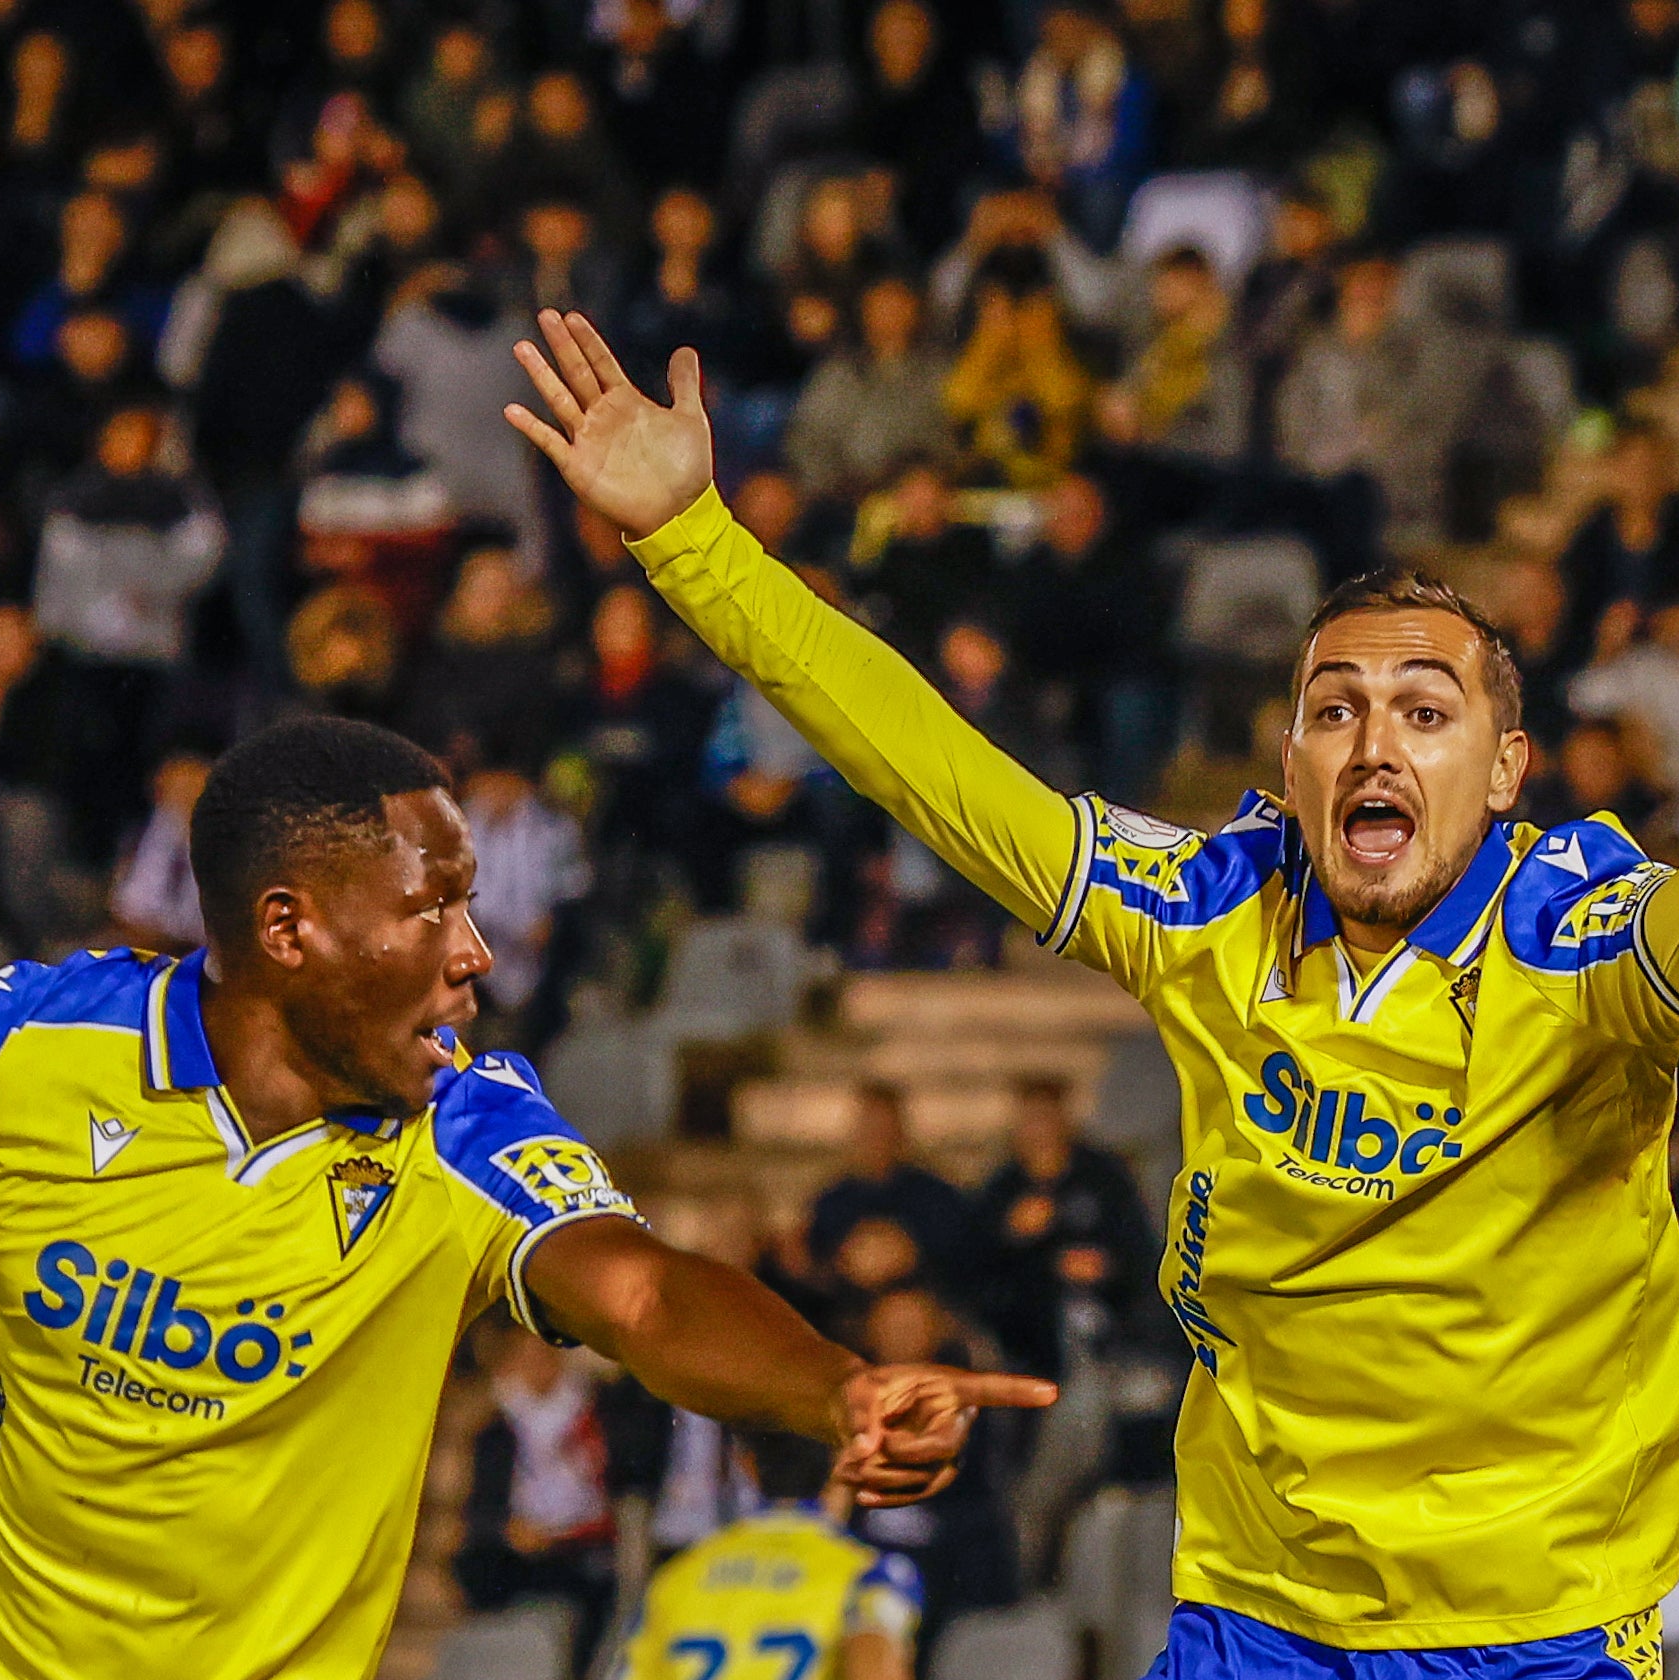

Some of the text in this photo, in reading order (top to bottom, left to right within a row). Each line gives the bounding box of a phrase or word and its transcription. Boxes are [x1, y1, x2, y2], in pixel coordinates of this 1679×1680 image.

[1274, 1152, 1395, 1201] Telecom
[24, 1241, 282, 1385] Silbö
[77, 1353, 226, 1422] Telecom
